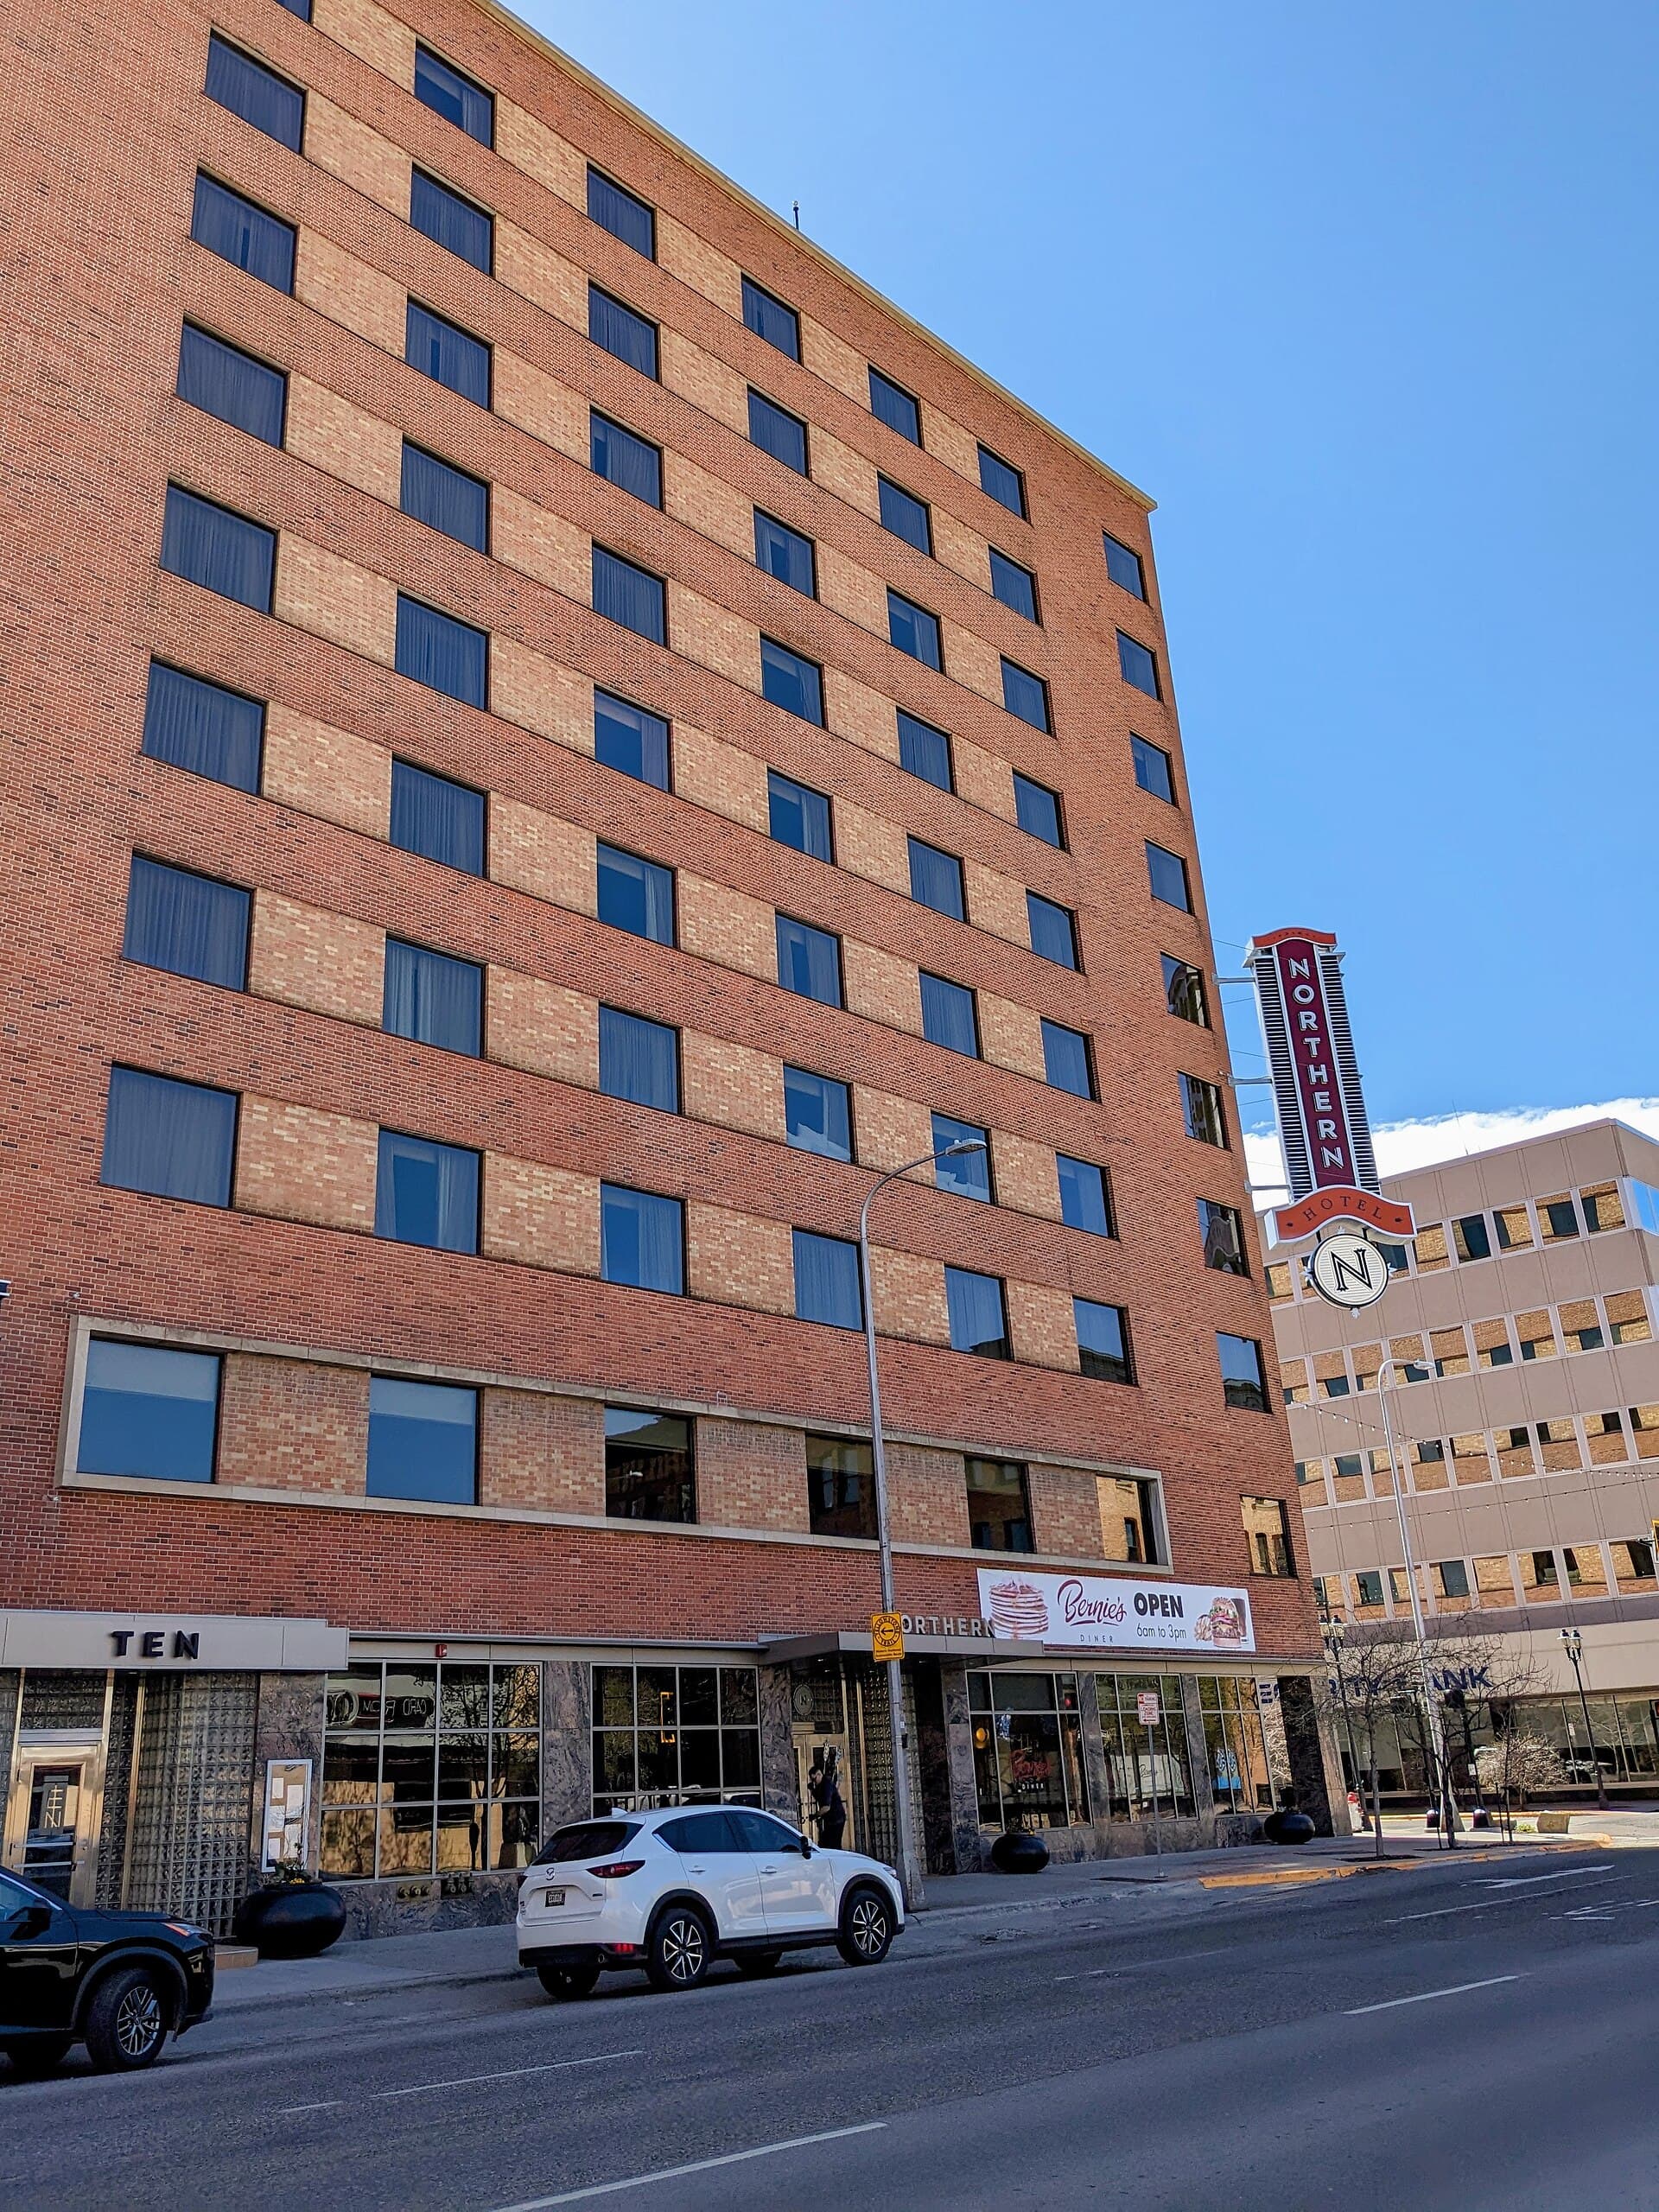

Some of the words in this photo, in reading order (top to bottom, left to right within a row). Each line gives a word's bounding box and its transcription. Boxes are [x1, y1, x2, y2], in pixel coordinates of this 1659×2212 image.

[1288, 957, 1344, 1169] NORTHERN
[1302, 1195, 1383, 1222] HOTEL
[1330, 1247, 1374, 1293] N
[1057, 1579, 1128, 1624] Bernie's
[1133, 1592, 1185, 1618] OPEN
[901, 1614, 996, 1638] ORTHERN
[1080, 1633, 1114, 1643] DINER
[1136, 1622, 1156, 1638] 6am
[1157, 1625, 1166, 1639] to
[1168, 1624, 1187, 1642] 3pm
[110, 1630, 200, 1660] TEN
